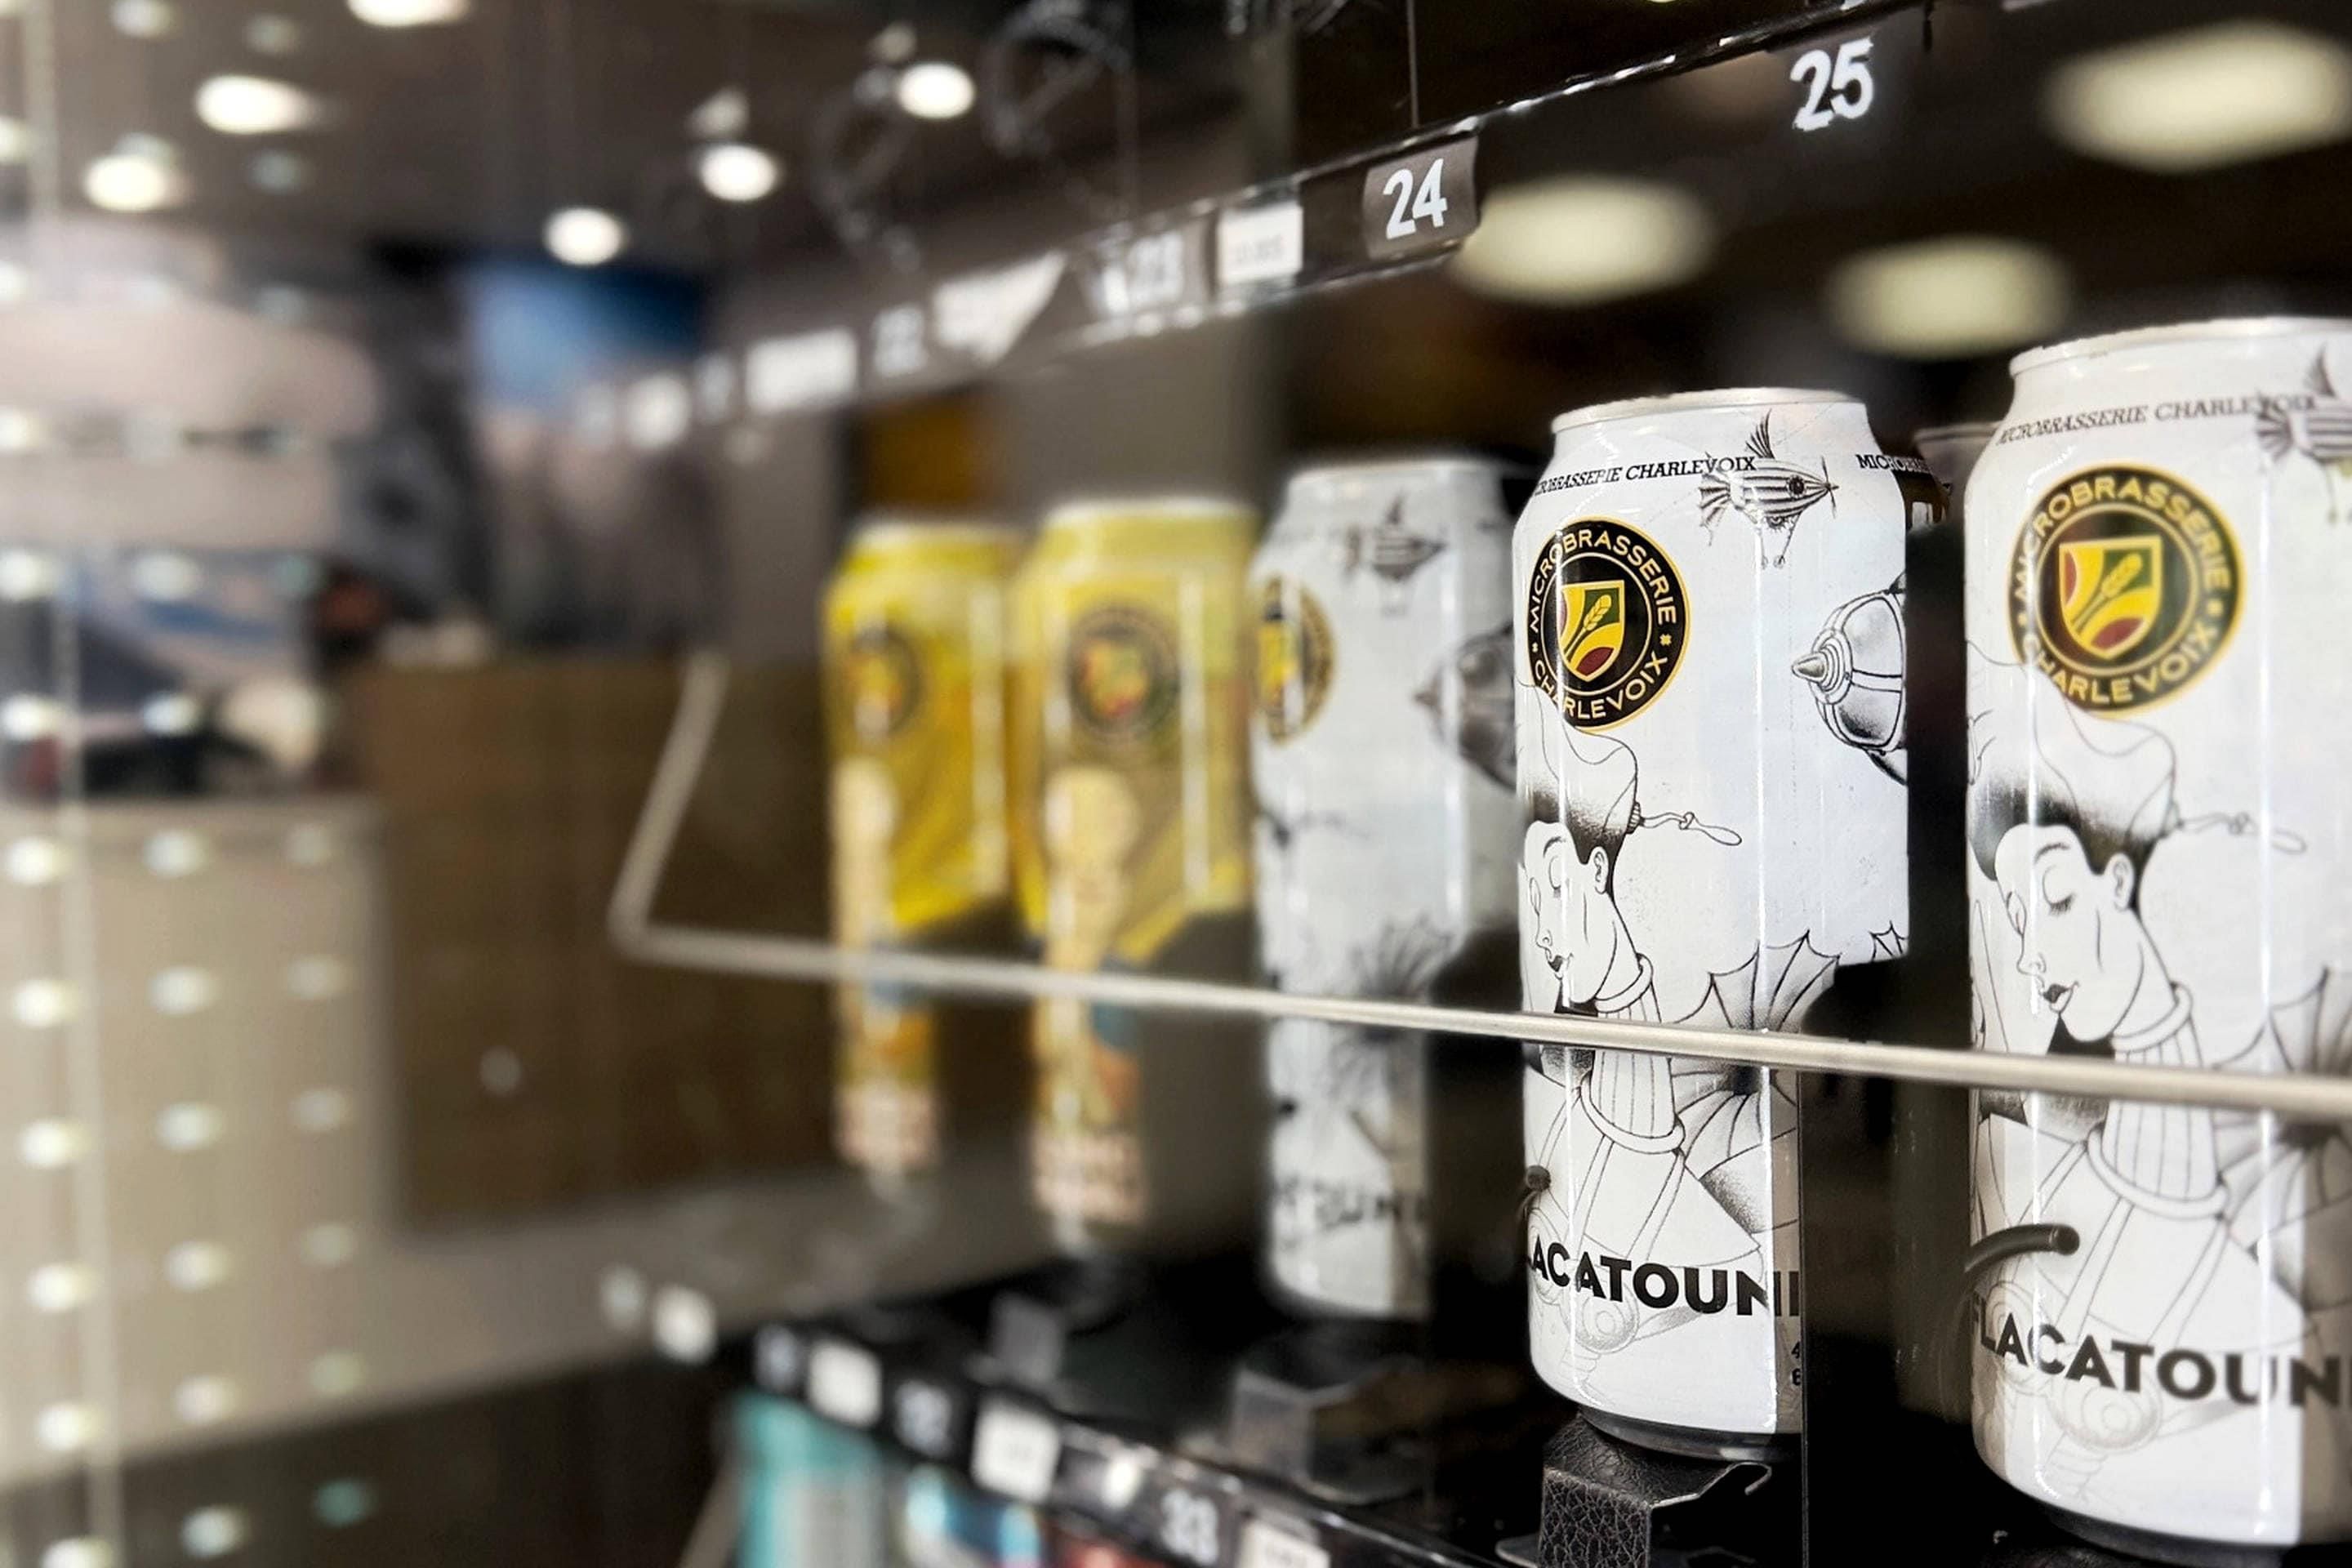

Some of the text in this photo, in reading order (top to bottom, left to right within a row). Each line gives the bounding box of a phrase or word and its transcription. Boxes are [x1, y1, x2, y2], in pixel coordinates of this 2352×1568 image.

[1789, 37, 1874, 131] 25
[1384, 158, 1448, 239] 24
[1626, 456, 1757, 480] CHARLEVOIX
[1530, 528, 1677, 633] MICROBRASSERIE
[1535, 651, 1668, 719] CHARLEVOIX
[1973, 1290, 2352, 1409] LACATOUN
